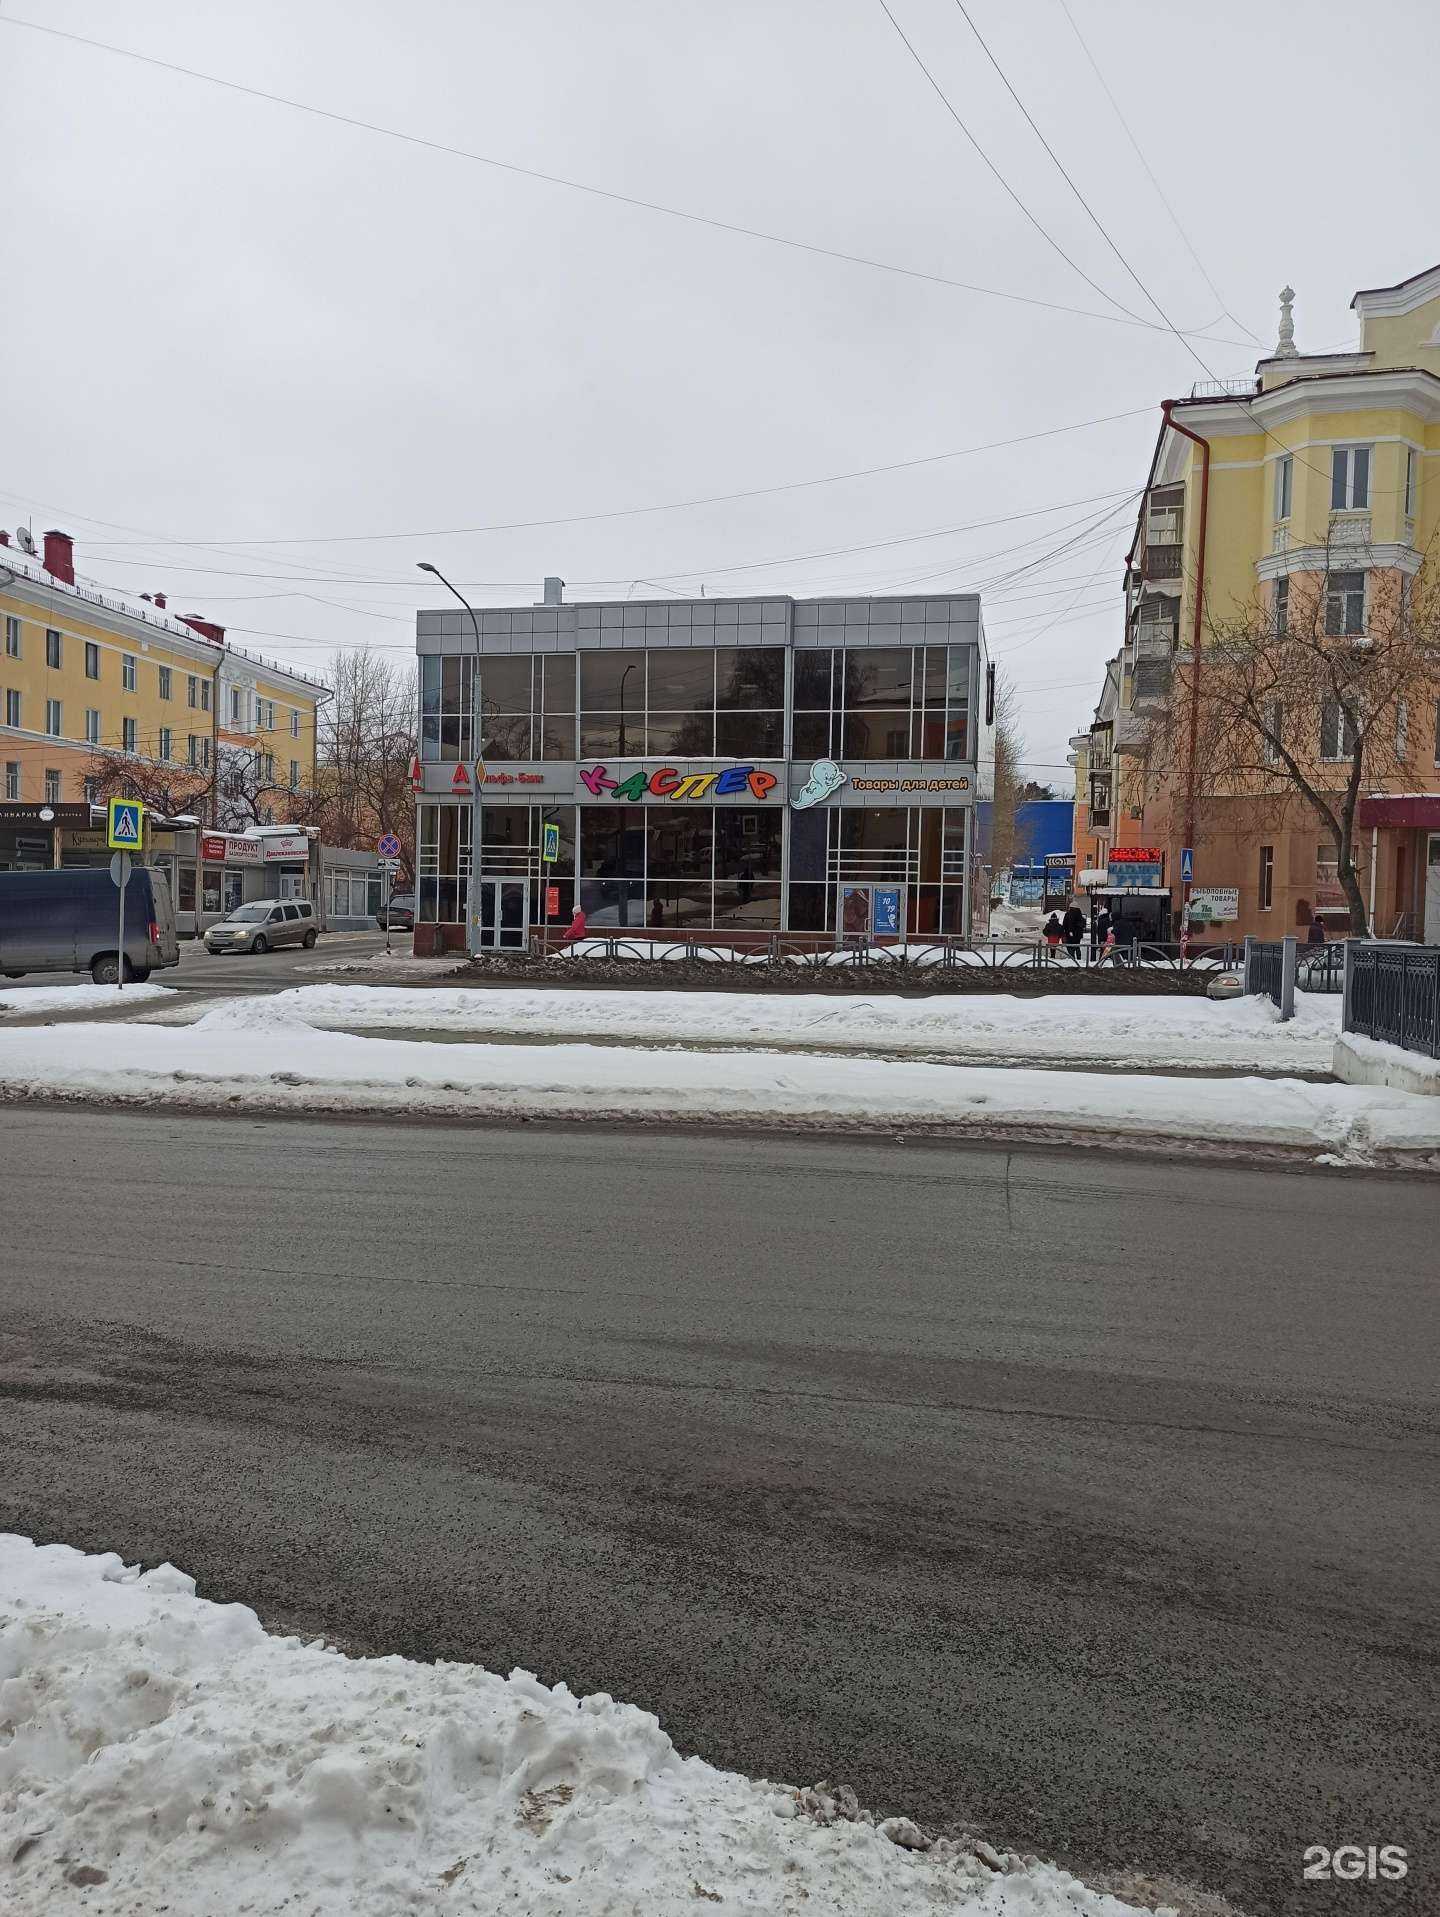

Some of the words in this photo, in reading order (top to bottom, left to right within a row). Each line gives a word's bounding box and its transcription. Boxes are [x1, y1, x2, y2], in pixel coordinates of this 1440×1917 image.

[579, 765, 777, 801] КАСПЕР
[852, 777, 899, 793] Товары
[900, 778, 927, 792] для
[927, 776, 969, 792] детей
[228, 840, 258, 853] ПРОДУКТ
